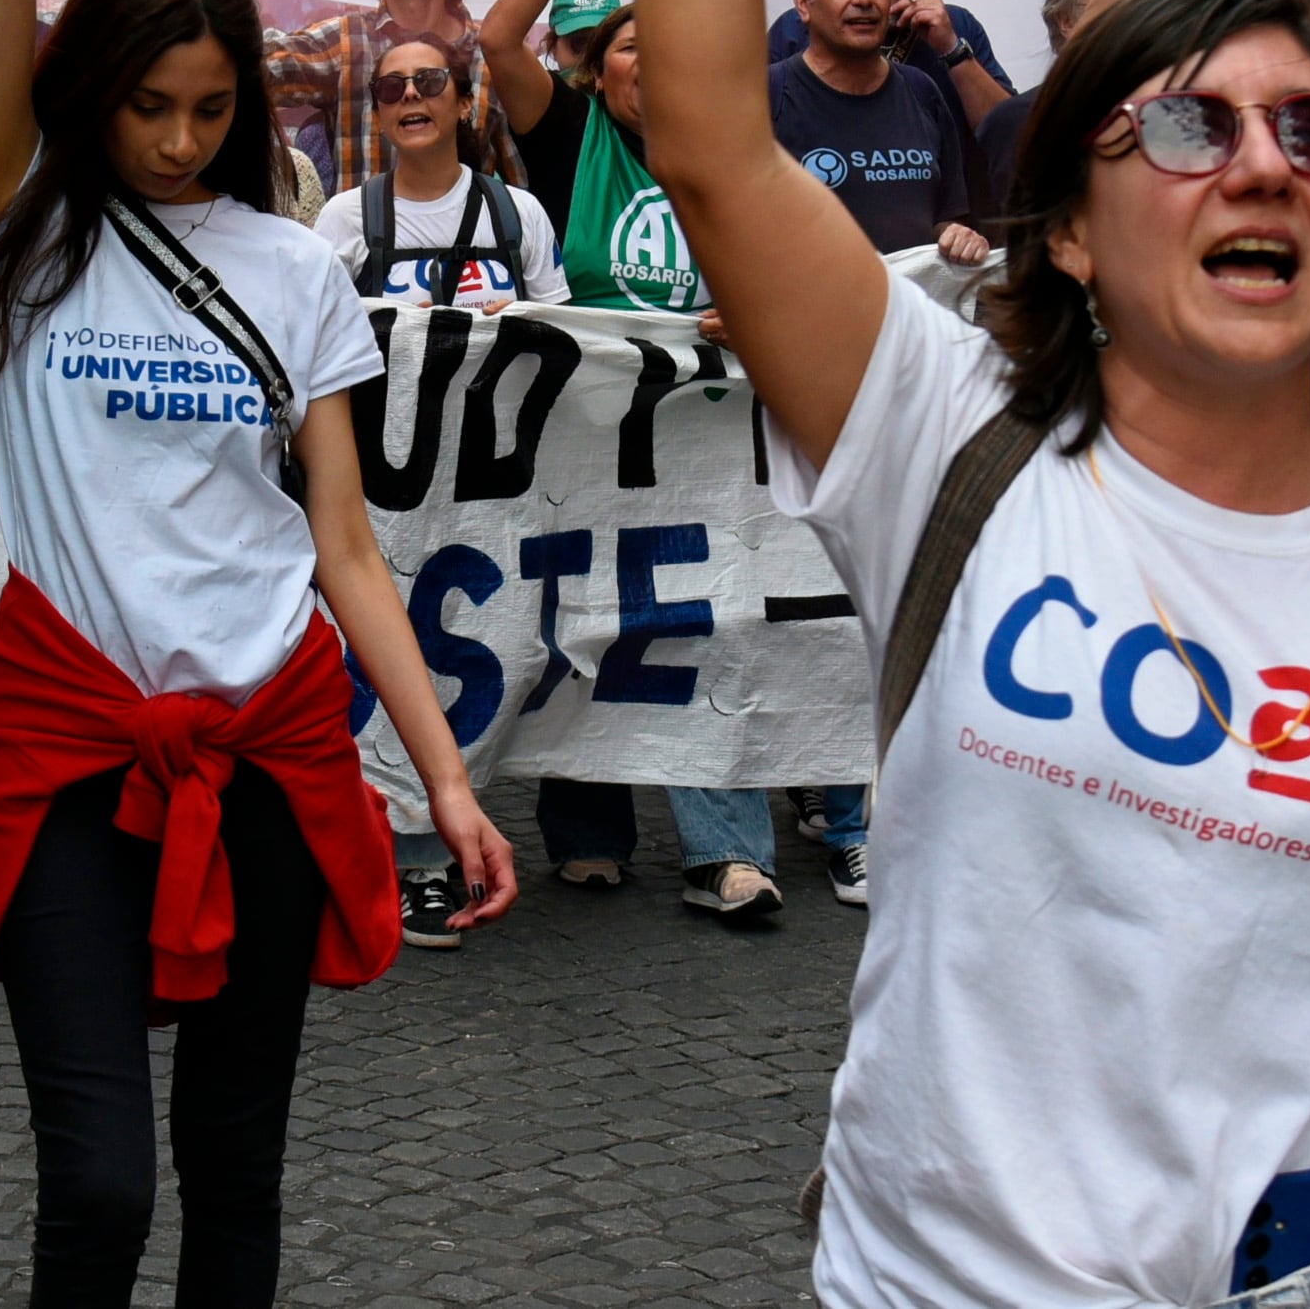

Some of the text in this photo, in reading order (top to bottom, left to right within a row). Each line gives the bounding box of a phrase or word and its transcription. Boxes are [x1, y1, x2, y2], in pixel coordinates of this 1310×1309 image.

[851, 148, 933, 168] SADOP
[864, 168, 932, 182] ROSARIO
[610, 260, 695, 288] ROSARIO
[99, 332, 219, 355] DEFIENDO
[61, 354, 263, 387] UNIVERSIDA
[958, 726, 1075, 789] Docentes
[1082, 777, 1100, 796] e
